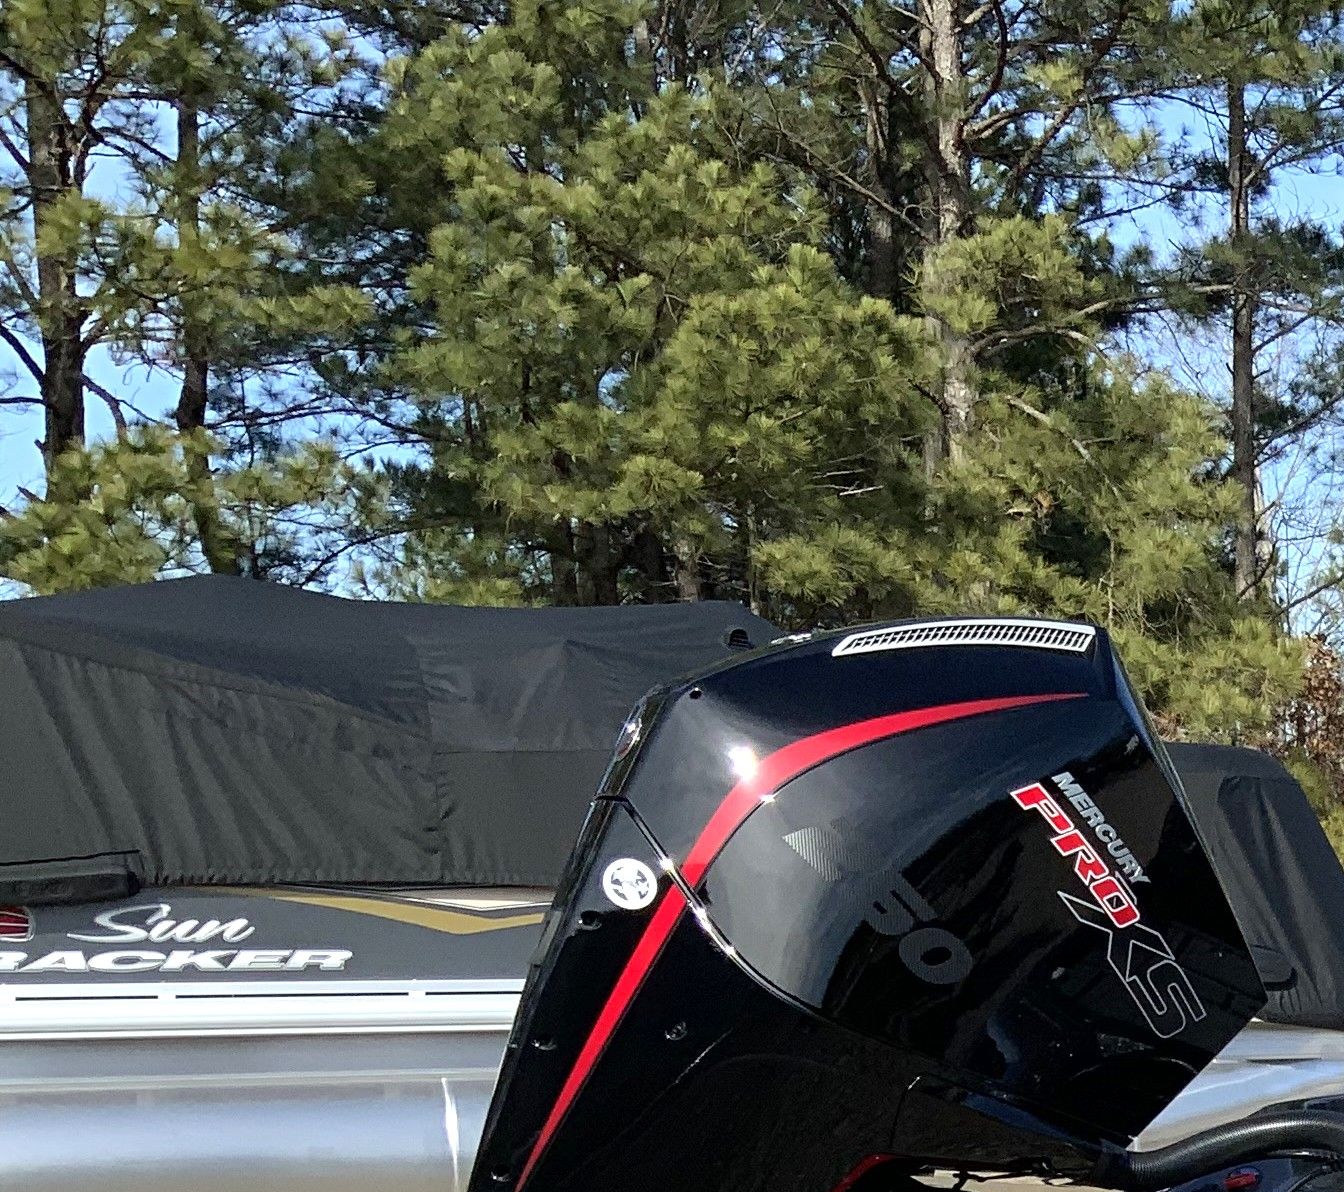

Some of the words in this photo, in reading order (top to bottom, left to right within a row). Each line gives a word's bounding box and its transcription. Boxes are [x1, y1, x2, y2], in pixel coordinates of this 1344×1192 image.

[1010, 782, 1141, 929] PRO
[1051, 771, 1152, 885] MERCURY
[67, 903, 256, 943] Sun
[1057, 871, 1208, 1039] XS
